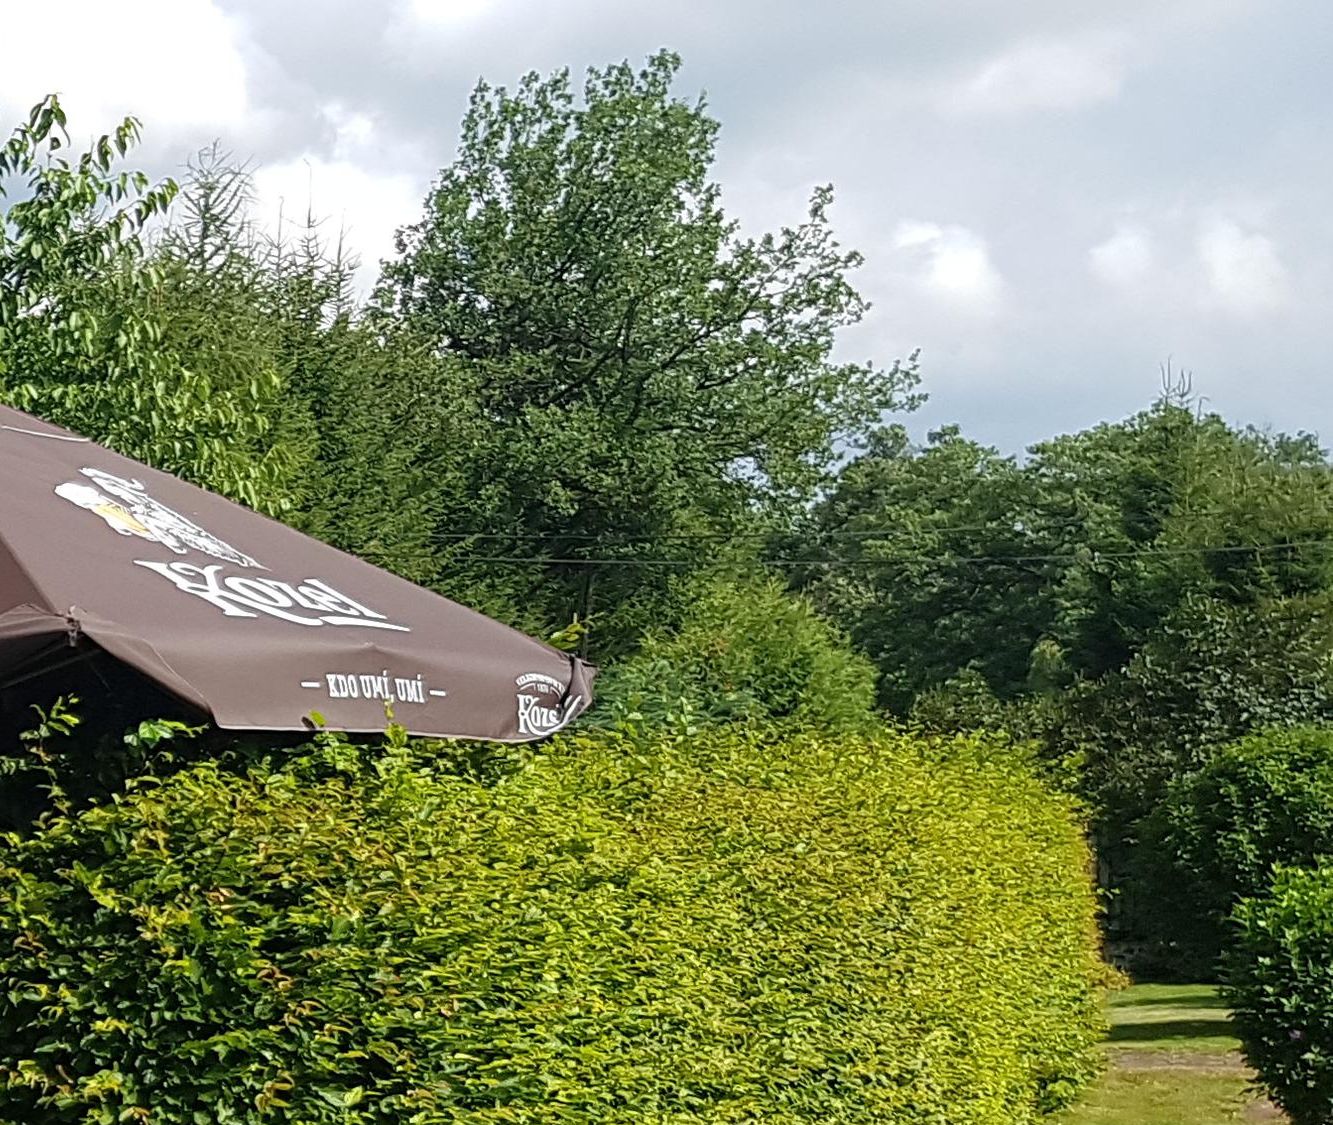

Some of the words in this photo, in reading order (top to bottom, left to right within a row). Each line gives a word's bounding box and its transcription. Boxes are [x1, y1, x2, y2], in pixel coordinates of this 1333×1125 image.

[133, 559, 389, 626] Kozel
[325, 674, 359, 698] KDO
[394, 673, 425, 704] UMÍ
